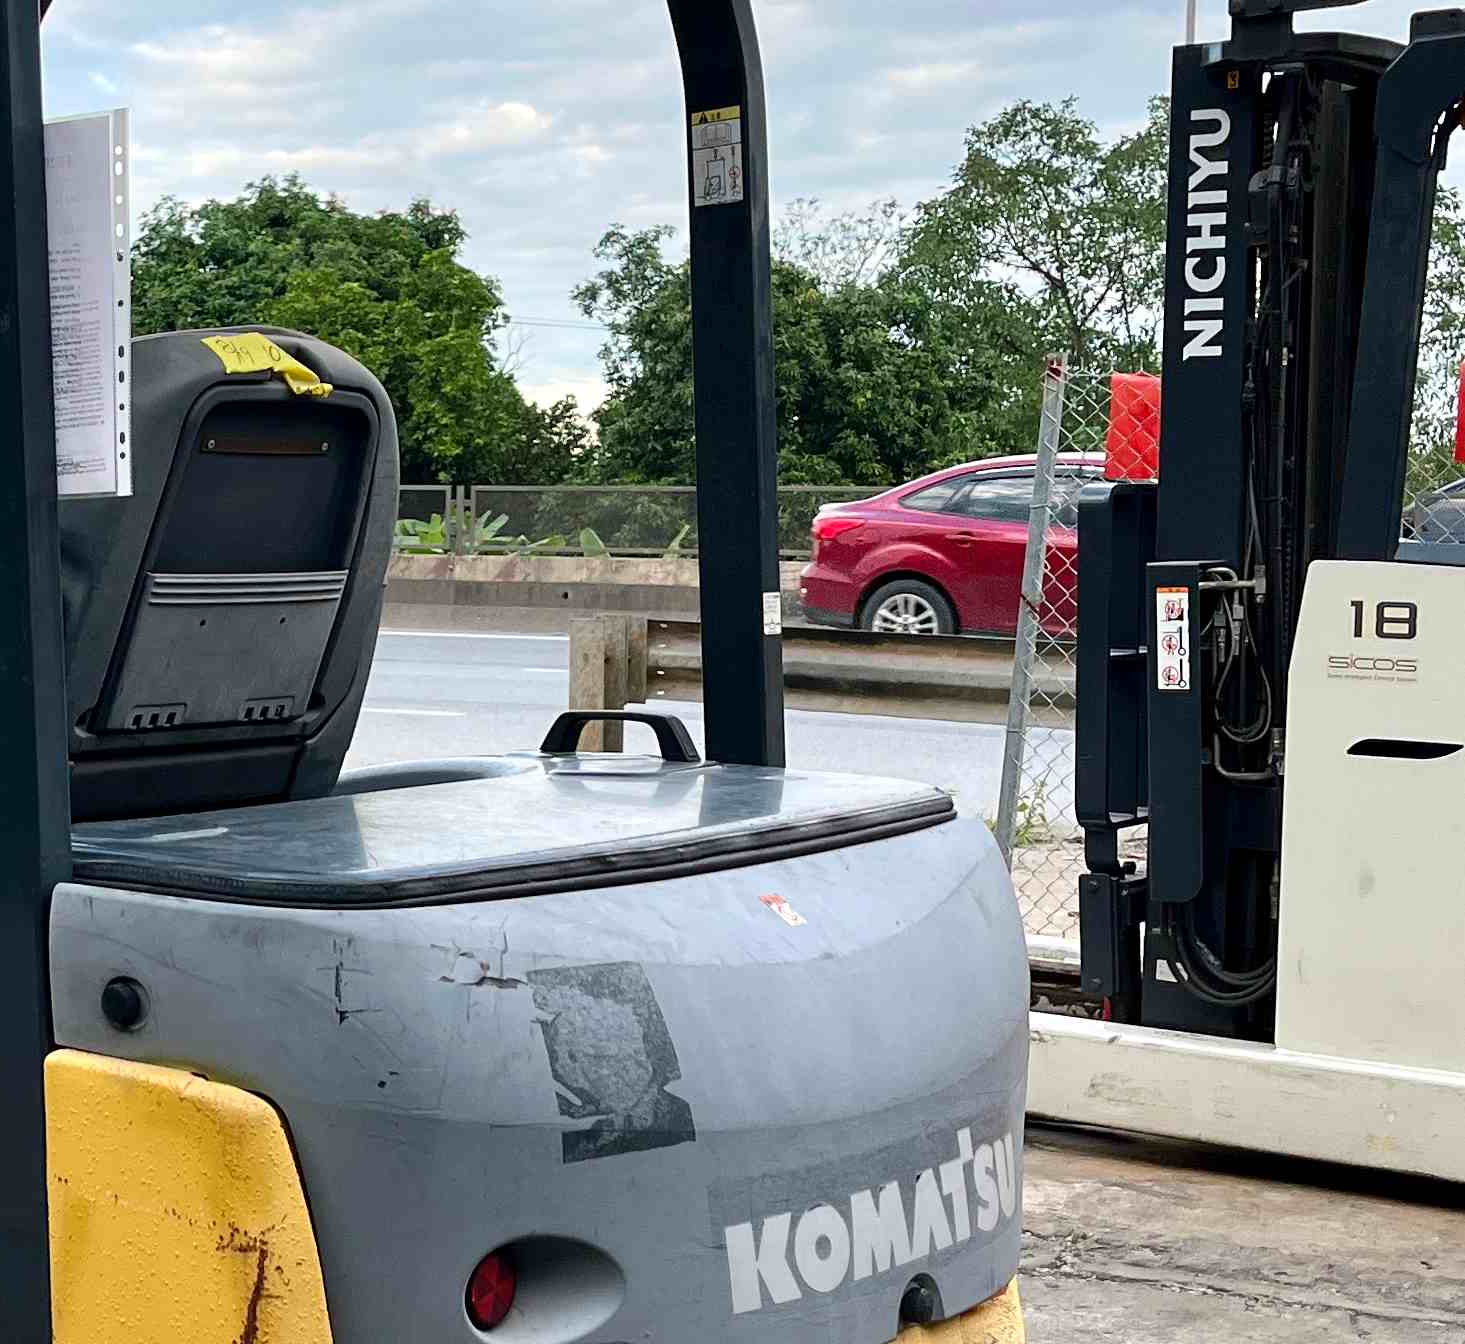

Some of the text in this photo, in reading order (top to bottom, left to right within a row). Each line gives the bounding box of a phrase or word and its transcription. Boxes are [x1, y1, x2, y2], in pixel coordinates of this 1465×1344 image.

[1183, 108, 1231, 361] NICHIYU
[1351, 601, 1417, 639] 18
[725, 1127, 1016, 1314] KOMATSU
